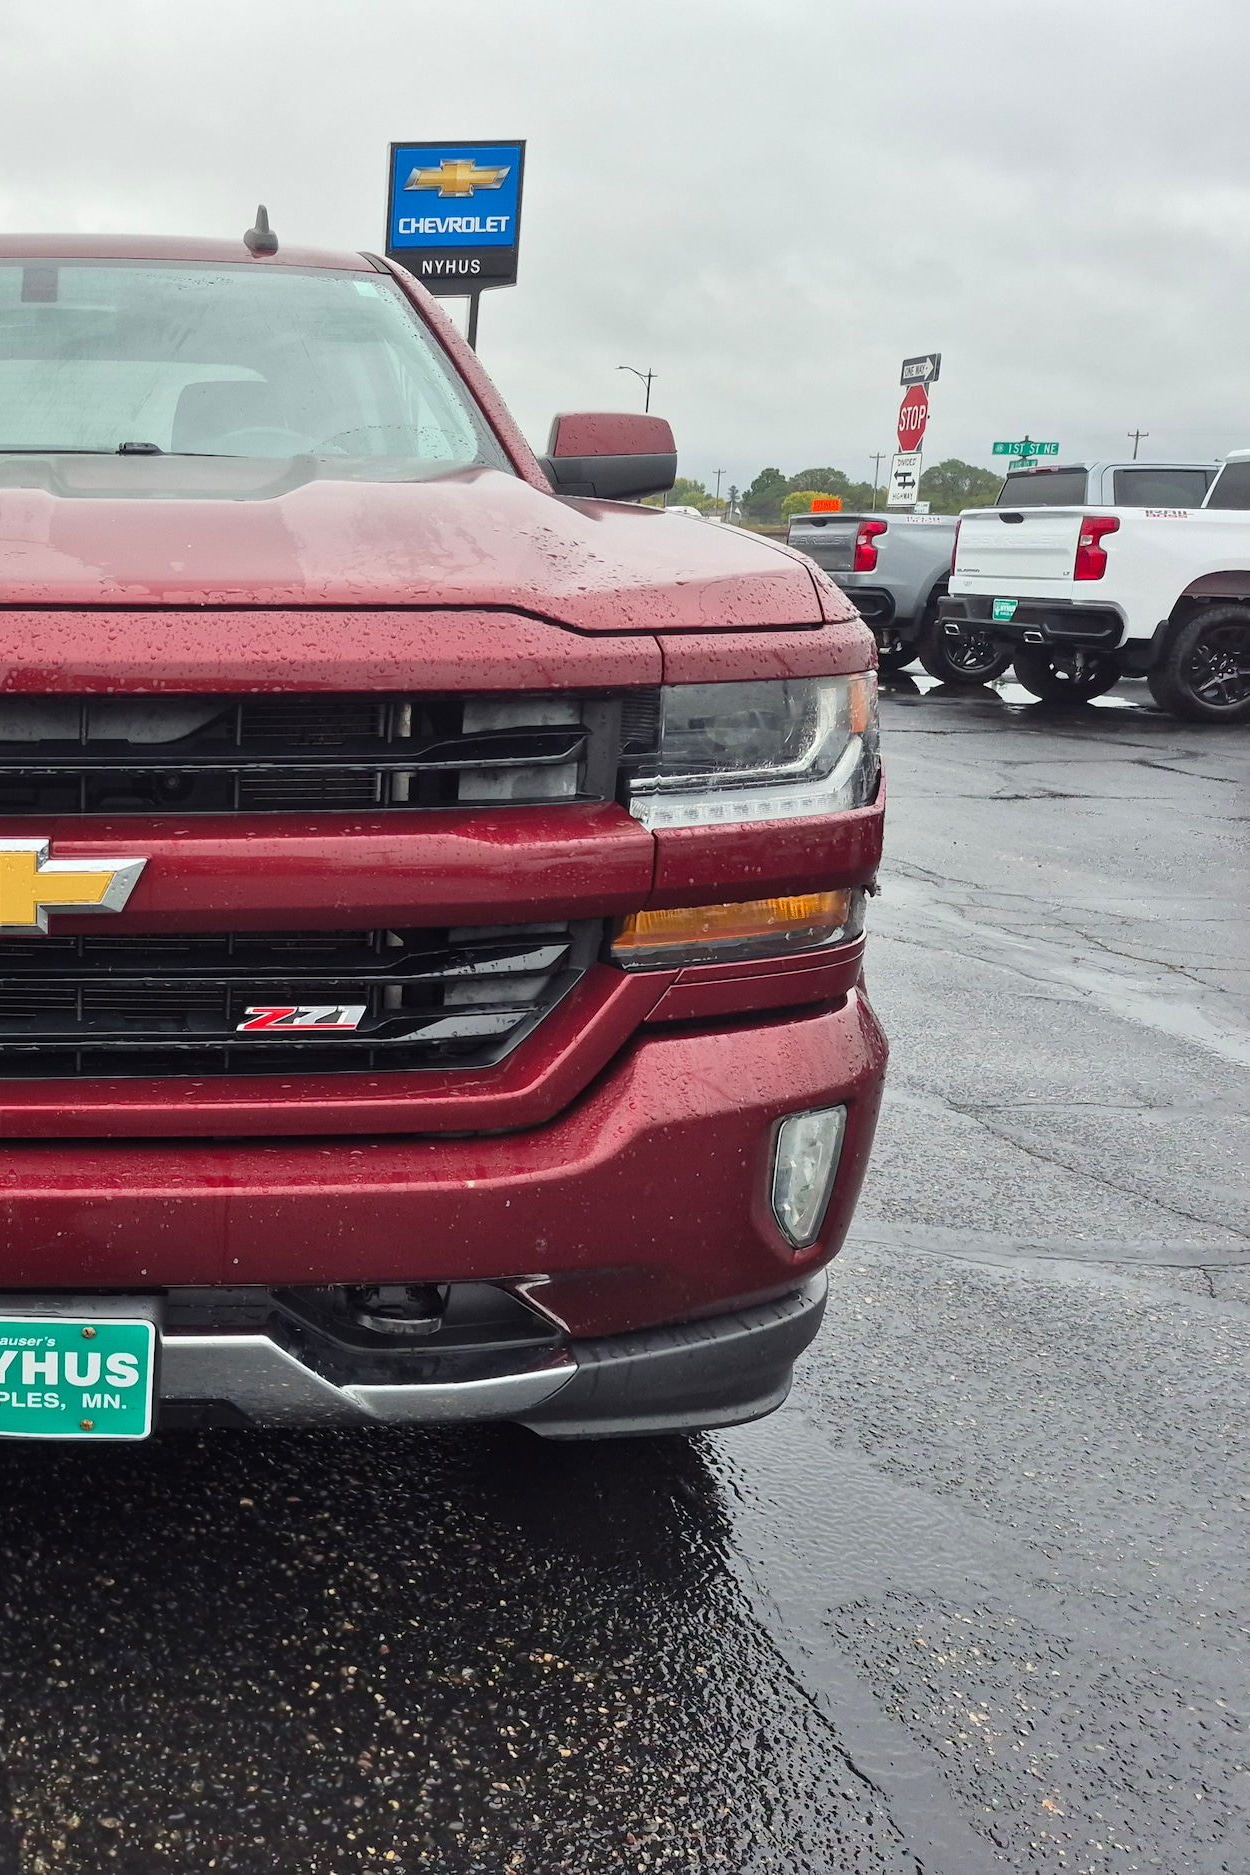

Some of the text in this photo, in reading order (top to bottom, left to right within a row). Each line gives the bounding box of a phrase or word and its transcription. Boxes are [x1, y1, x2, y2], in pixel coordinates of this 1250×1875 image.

[398, 216, 510, 234] CHEVROLET
[421, 259, 481, 275] NYHUS
[905, 365, 925, 377] ONE WAY
[898, 405, 926, 431] STOP
[1008, 443, 1057, 454] 1ST ST NE
[897, 458, 917, 467] DIVIDED
[892, 492, 914, 501] HIGHWAY
[236, 1005, 367, 1031] Z71
[81, 1393, 127, 1410] MN.
